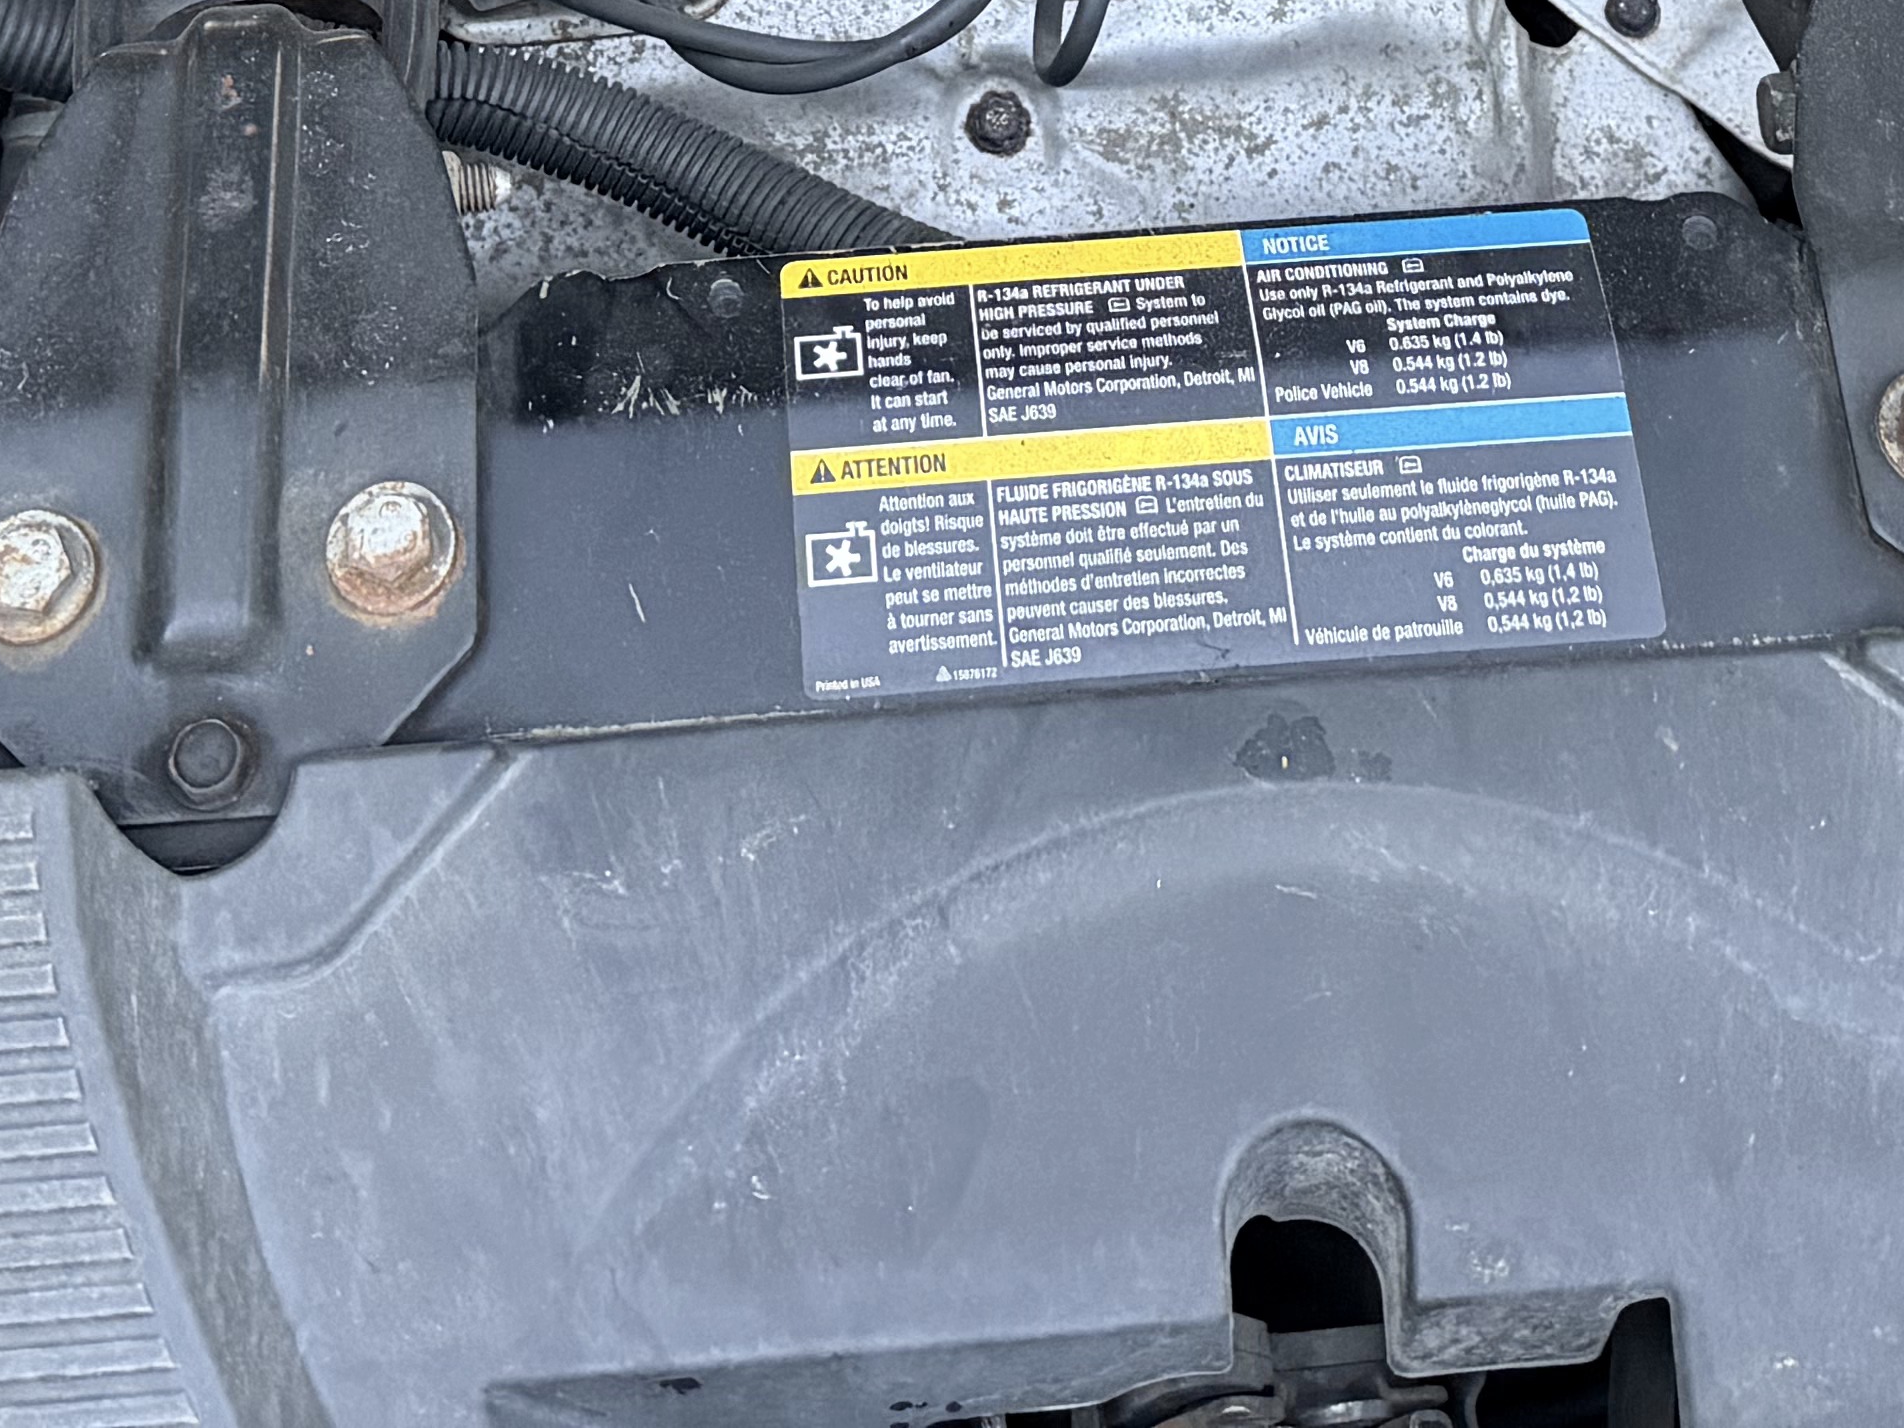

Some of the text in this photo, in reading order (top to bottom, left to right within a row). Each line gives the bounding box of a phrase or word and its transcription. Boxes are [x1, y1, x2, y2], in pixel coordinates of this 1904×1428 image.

[1262, 233, 1329, 255] NOTICE
[826, 264, 908, 285] CAUTION
[1256, 261, 1389, 284] AIR CONDITIONING
[976, 275, 1186, 303] R-134a REFRIGERANT UNDER
[1258, 269, 1574, 302] Use only R-134a Refrigerant and Polyalkylene
[862, 291, 956, 312] To help avoid
[978, 293, 1206, 322] HIGH PRESSURE System to
[1262, 288, 1571, 323] Glycol oil (PAG oil). The system contains dye.
[864, 312, 927, 333] personal
[980, 309, 1220, 341] be serviced by qualified personnel
[1385, 313, 1497, 333] System Charge
[866, 332, 948, 351] injury, keep
[982, 331, 1203, 362] only. Improper service methods
[1345, 329, 1504, 354] V6 0.635 kg (1.4 lb)
[867, 352, 912, 369] hands
[984, 354, 1173, 381] may cause personal injury.
[1349, 349, 1508, 376] V8 0.544 kg (1.2 lb)
[868, 369, 955, 389] clear of
[986, 366, 1256, 401] General Motors Corporation, Detroit, MI
[1274, 371, 1512, 403] Police Vehicle 0.544 kg (1.2 lb)
[870, 389, 949, 410] It can start
[872, 412, 957, 433] at any time.
[988, 403, 1057, 424] SAE J639
[1292, 423, 1339, 447] AVIS
[840, 453, 946, 480] ATTENTION
[1284, 459, 1385, 482] CLIMATISEUR
[996, 468, 1254, 503] FLUIDE FRIGORIGÈNE R-134a SOUS
[997, 501, 1127, 526] HAUTE PRESSION
[880, 514, 984, 537] doigts! Risque
[883, 561, 984, 583] Le ventilateur
